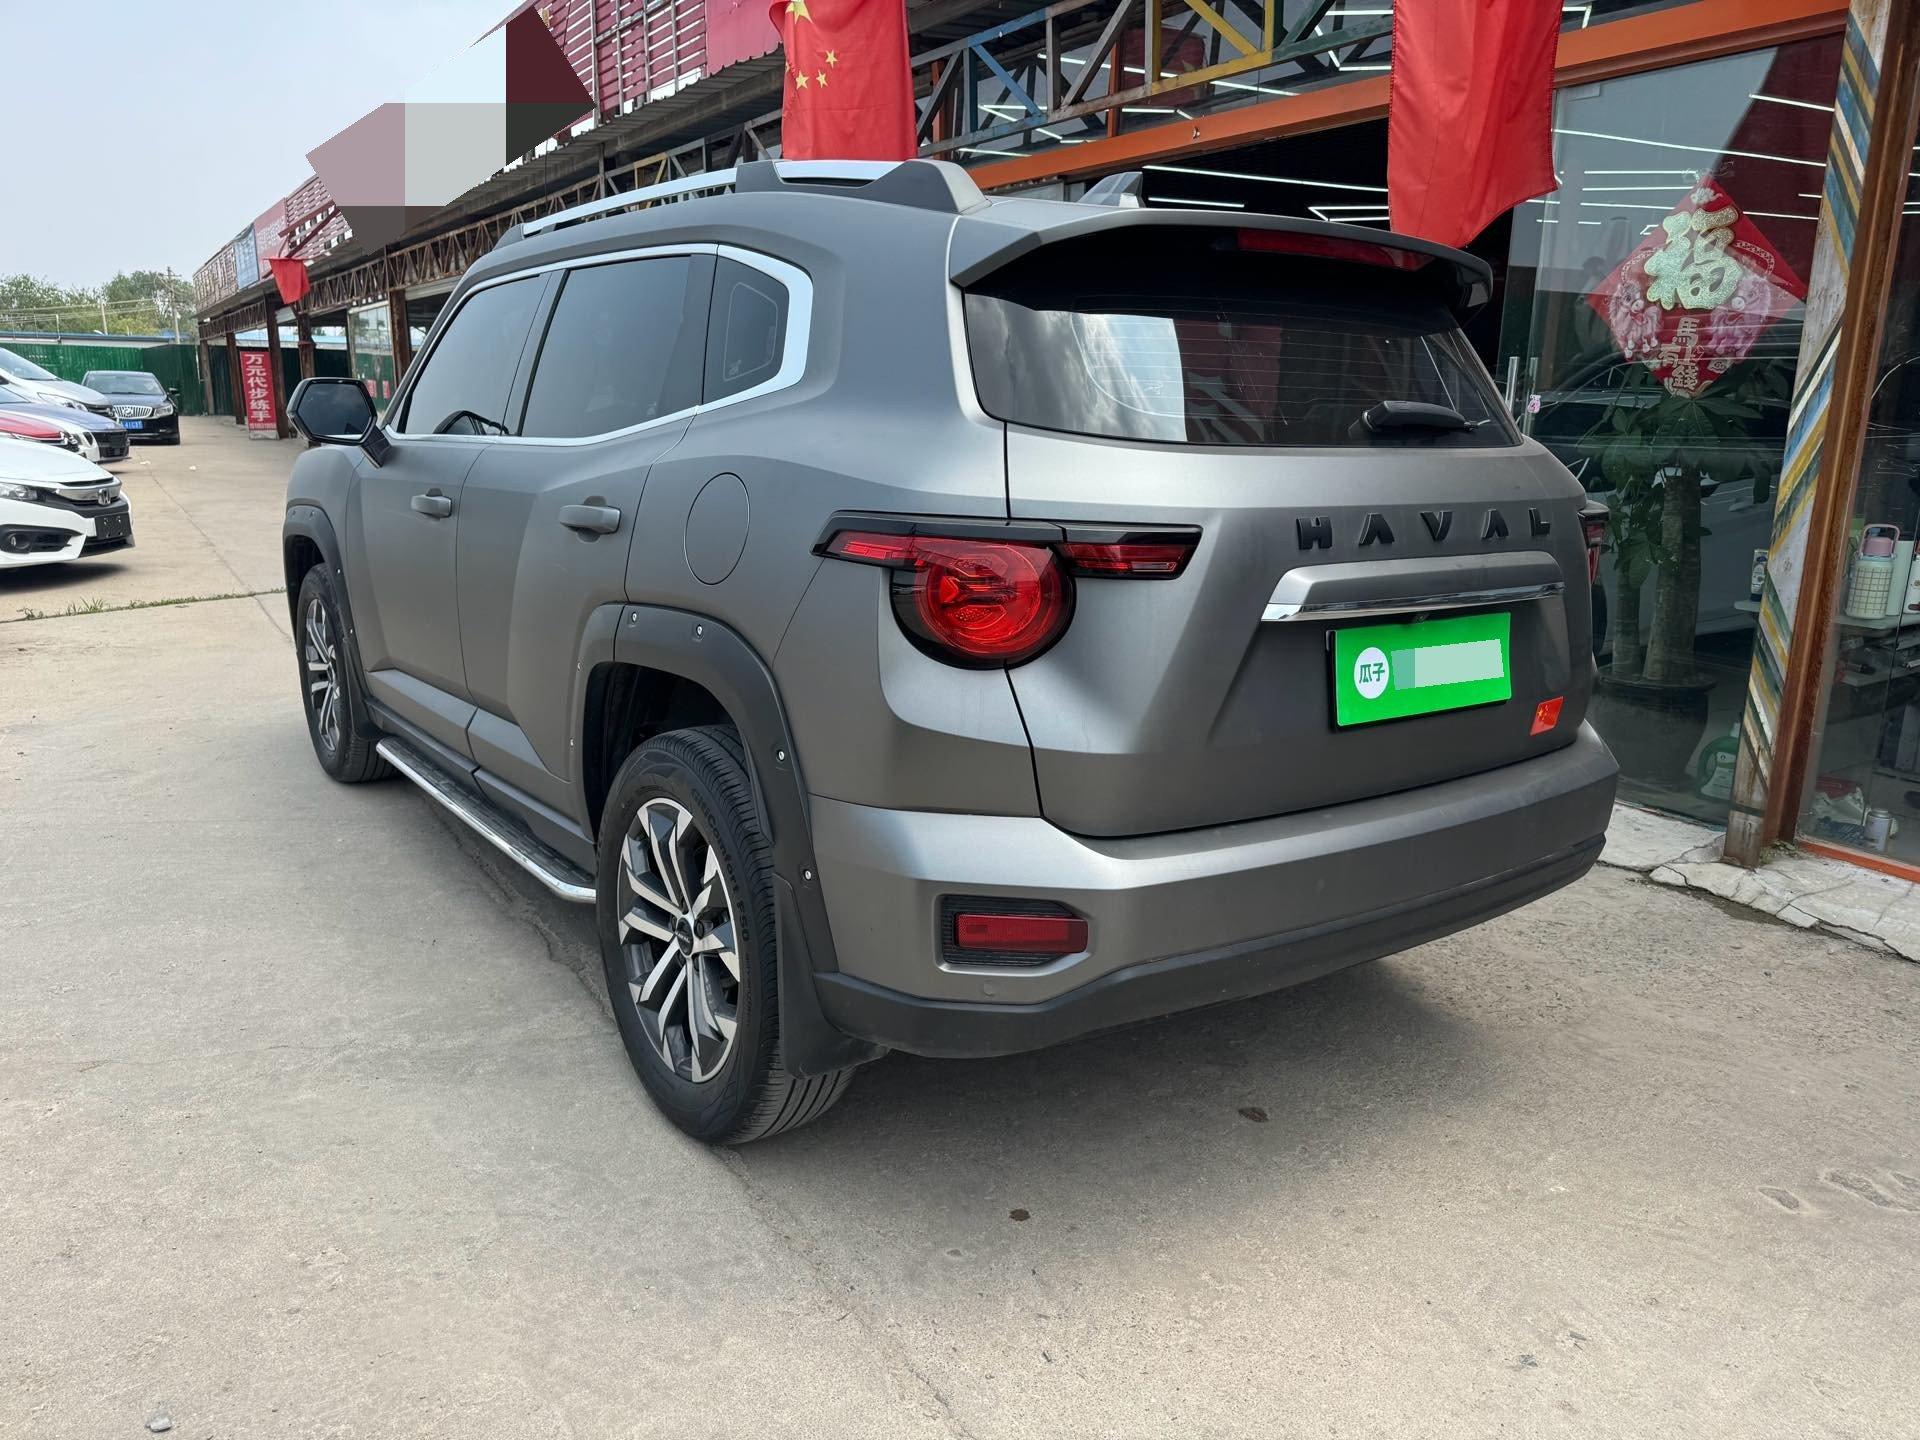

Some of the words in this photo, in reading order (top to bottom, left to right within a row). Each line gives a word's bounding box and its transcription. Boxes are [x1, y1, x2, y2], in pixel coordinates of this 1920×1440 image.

[1644, 207, 1743, 310] 福
[244, 354, 271, 422] 万元代步练手
[1295, 508, 1551, 550] HAVAL
